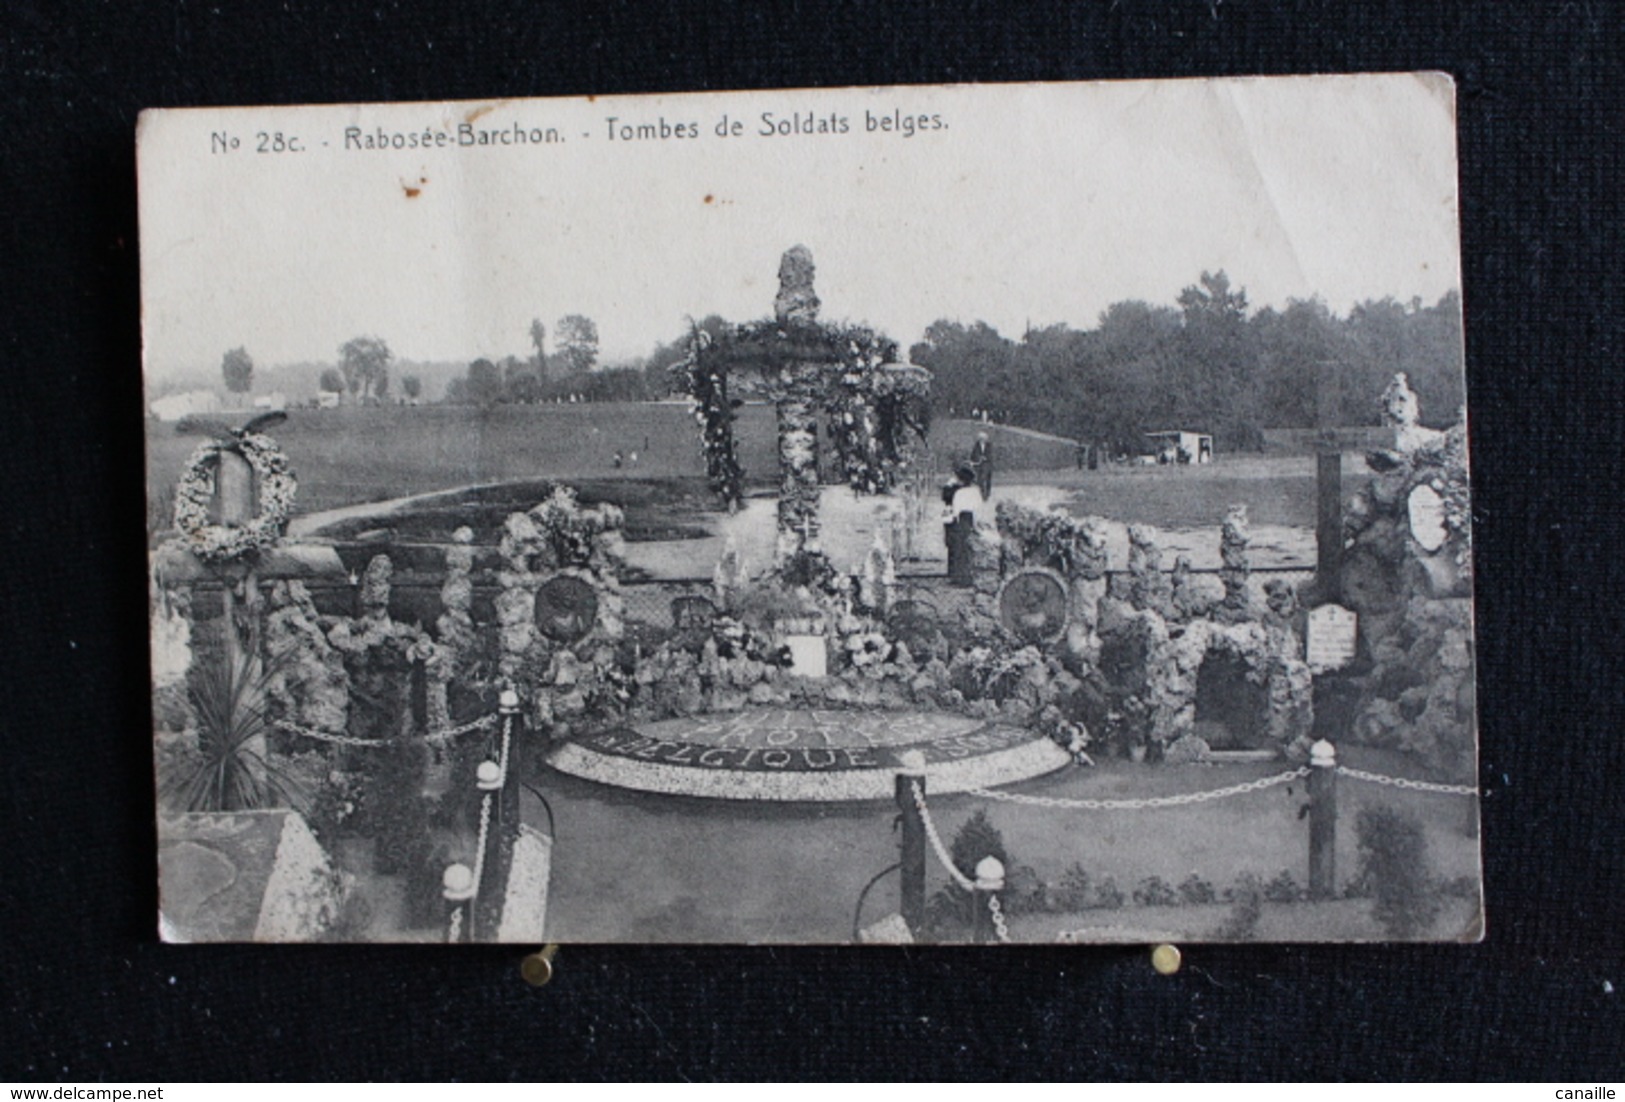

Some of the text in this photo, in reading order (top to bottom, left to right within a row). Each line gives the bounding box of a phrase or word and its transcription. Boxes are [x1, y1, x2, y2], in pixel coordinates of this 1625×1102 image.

[256, 131, 306, 153] 28c.
[344, 121, 566, 150] Rabosée-Barchon.
[606, 116, 699, 141] Tombes
[714, 114, 744, 138] de
[758, 111, 850, 137] Soldats
[865, 108, 950, 139] belges.
